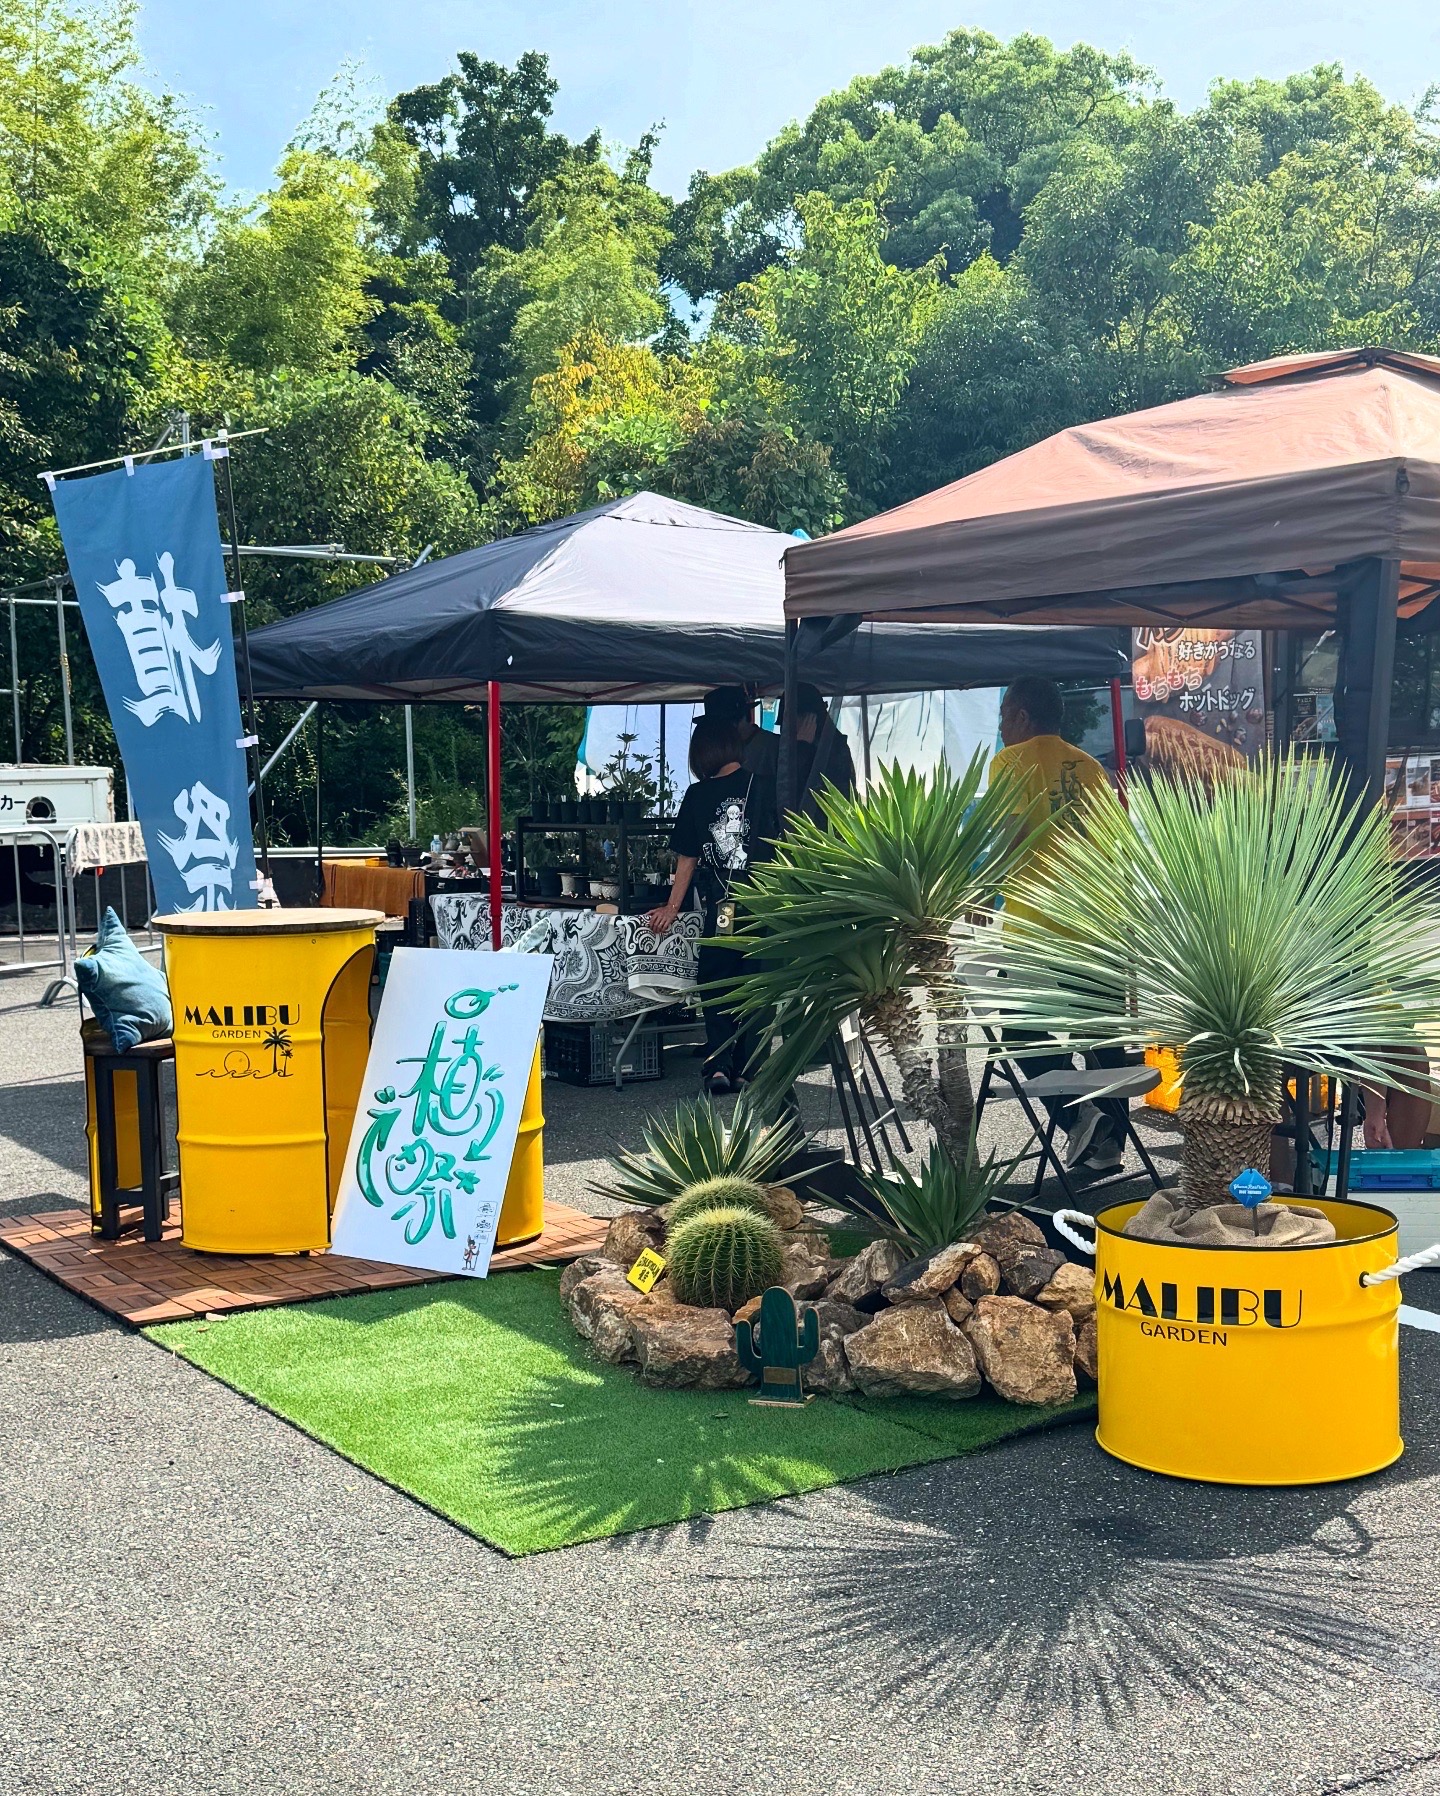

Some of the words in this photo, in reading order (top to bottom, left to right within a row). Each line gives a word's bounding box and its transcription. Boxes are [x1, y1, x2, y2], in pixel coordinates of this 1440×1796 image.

[1178, 640, 1256, 661] 好きがうなる
[1136, 666, 1203, 701] もちもち
[1179, 685, 1256, 712] ホットドッグ
[0, 794, 26, 811] カー
[183, 1003, 301, 1027] MALIBU
[211, 1029, 261, 1039] GARDEN
[1099, 1267, 1304, 1329] MALIBU
[1140, 1320, 1229, 1347] GARDEN
